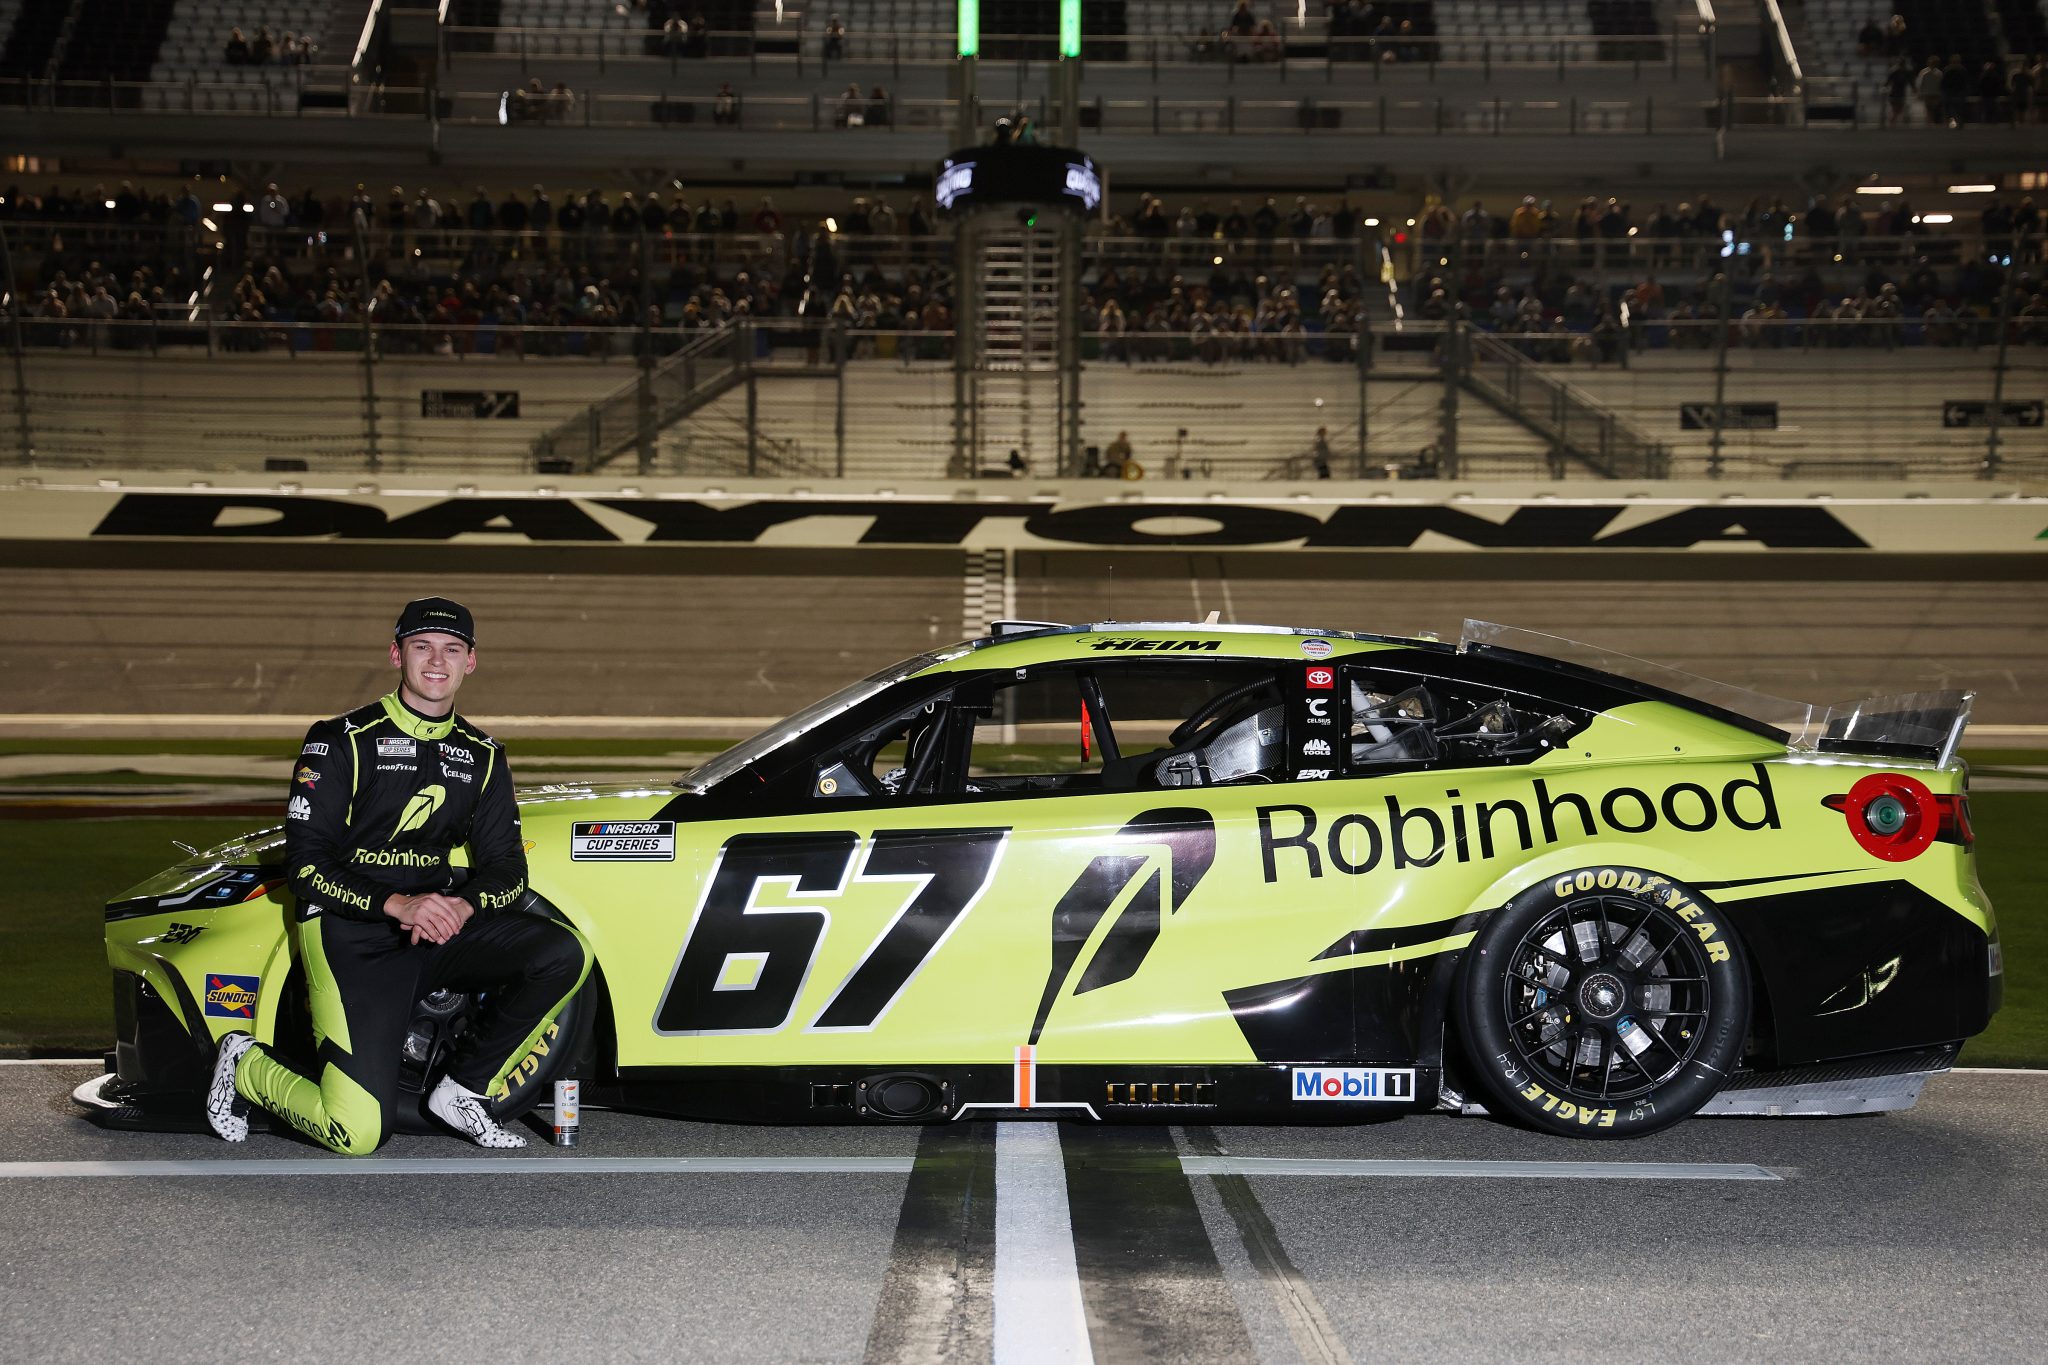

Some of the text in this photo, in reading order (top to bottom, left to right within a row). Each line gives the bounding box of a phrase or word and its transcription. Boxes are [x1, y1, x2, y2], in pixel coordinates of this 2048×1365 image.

[89, 493, 1873, 549] DAYTONA
[1090, 640, 1223, 651] HEIM
[1302, 738, 1332, 751] MAC
[376, 763, 418, 772] GOODYEAR
[605, 823, 660, 835] NASCAR
[1255, 762, 1782, 884] Robinhood
[586, 838, 661, 851] CUP SERIES
[1554, 868, 1733, 964] GOODYEAR
[651, 826, 1013, 1037] 67
[209, 990, 257, 1004] SUNOCO
[496, 1022, 560, 1103] EAGLE
[1296, 1072, 1377, 1097] Mobil
[1520, 1082, 1617, 1127] EAGLE
